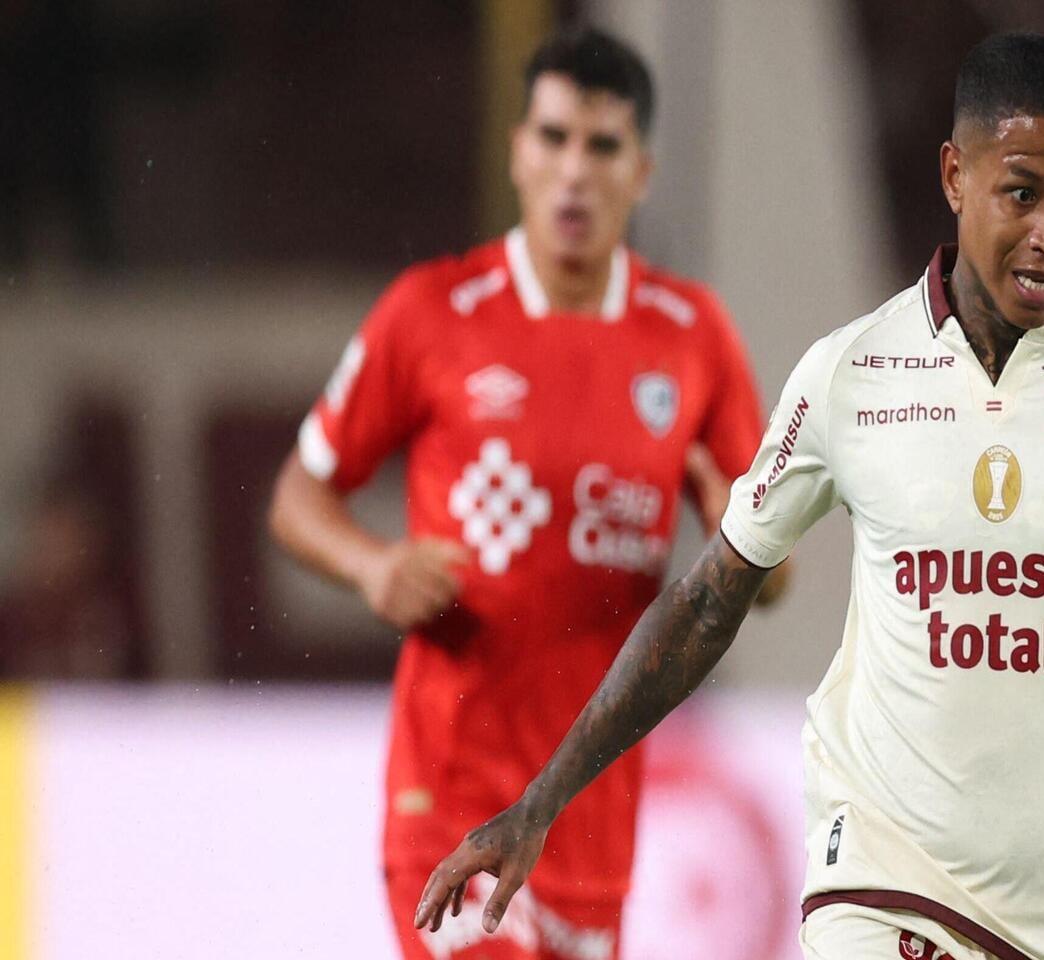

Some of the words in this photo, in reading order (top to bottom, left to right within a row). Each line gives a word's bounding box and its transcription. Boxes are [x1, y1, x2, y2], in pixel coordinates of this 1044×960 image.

[851, 355, 955, 369] JETOUR
[857, 402, 956, 426] marathon
[767, 395, 809, 484] MOVISUN
